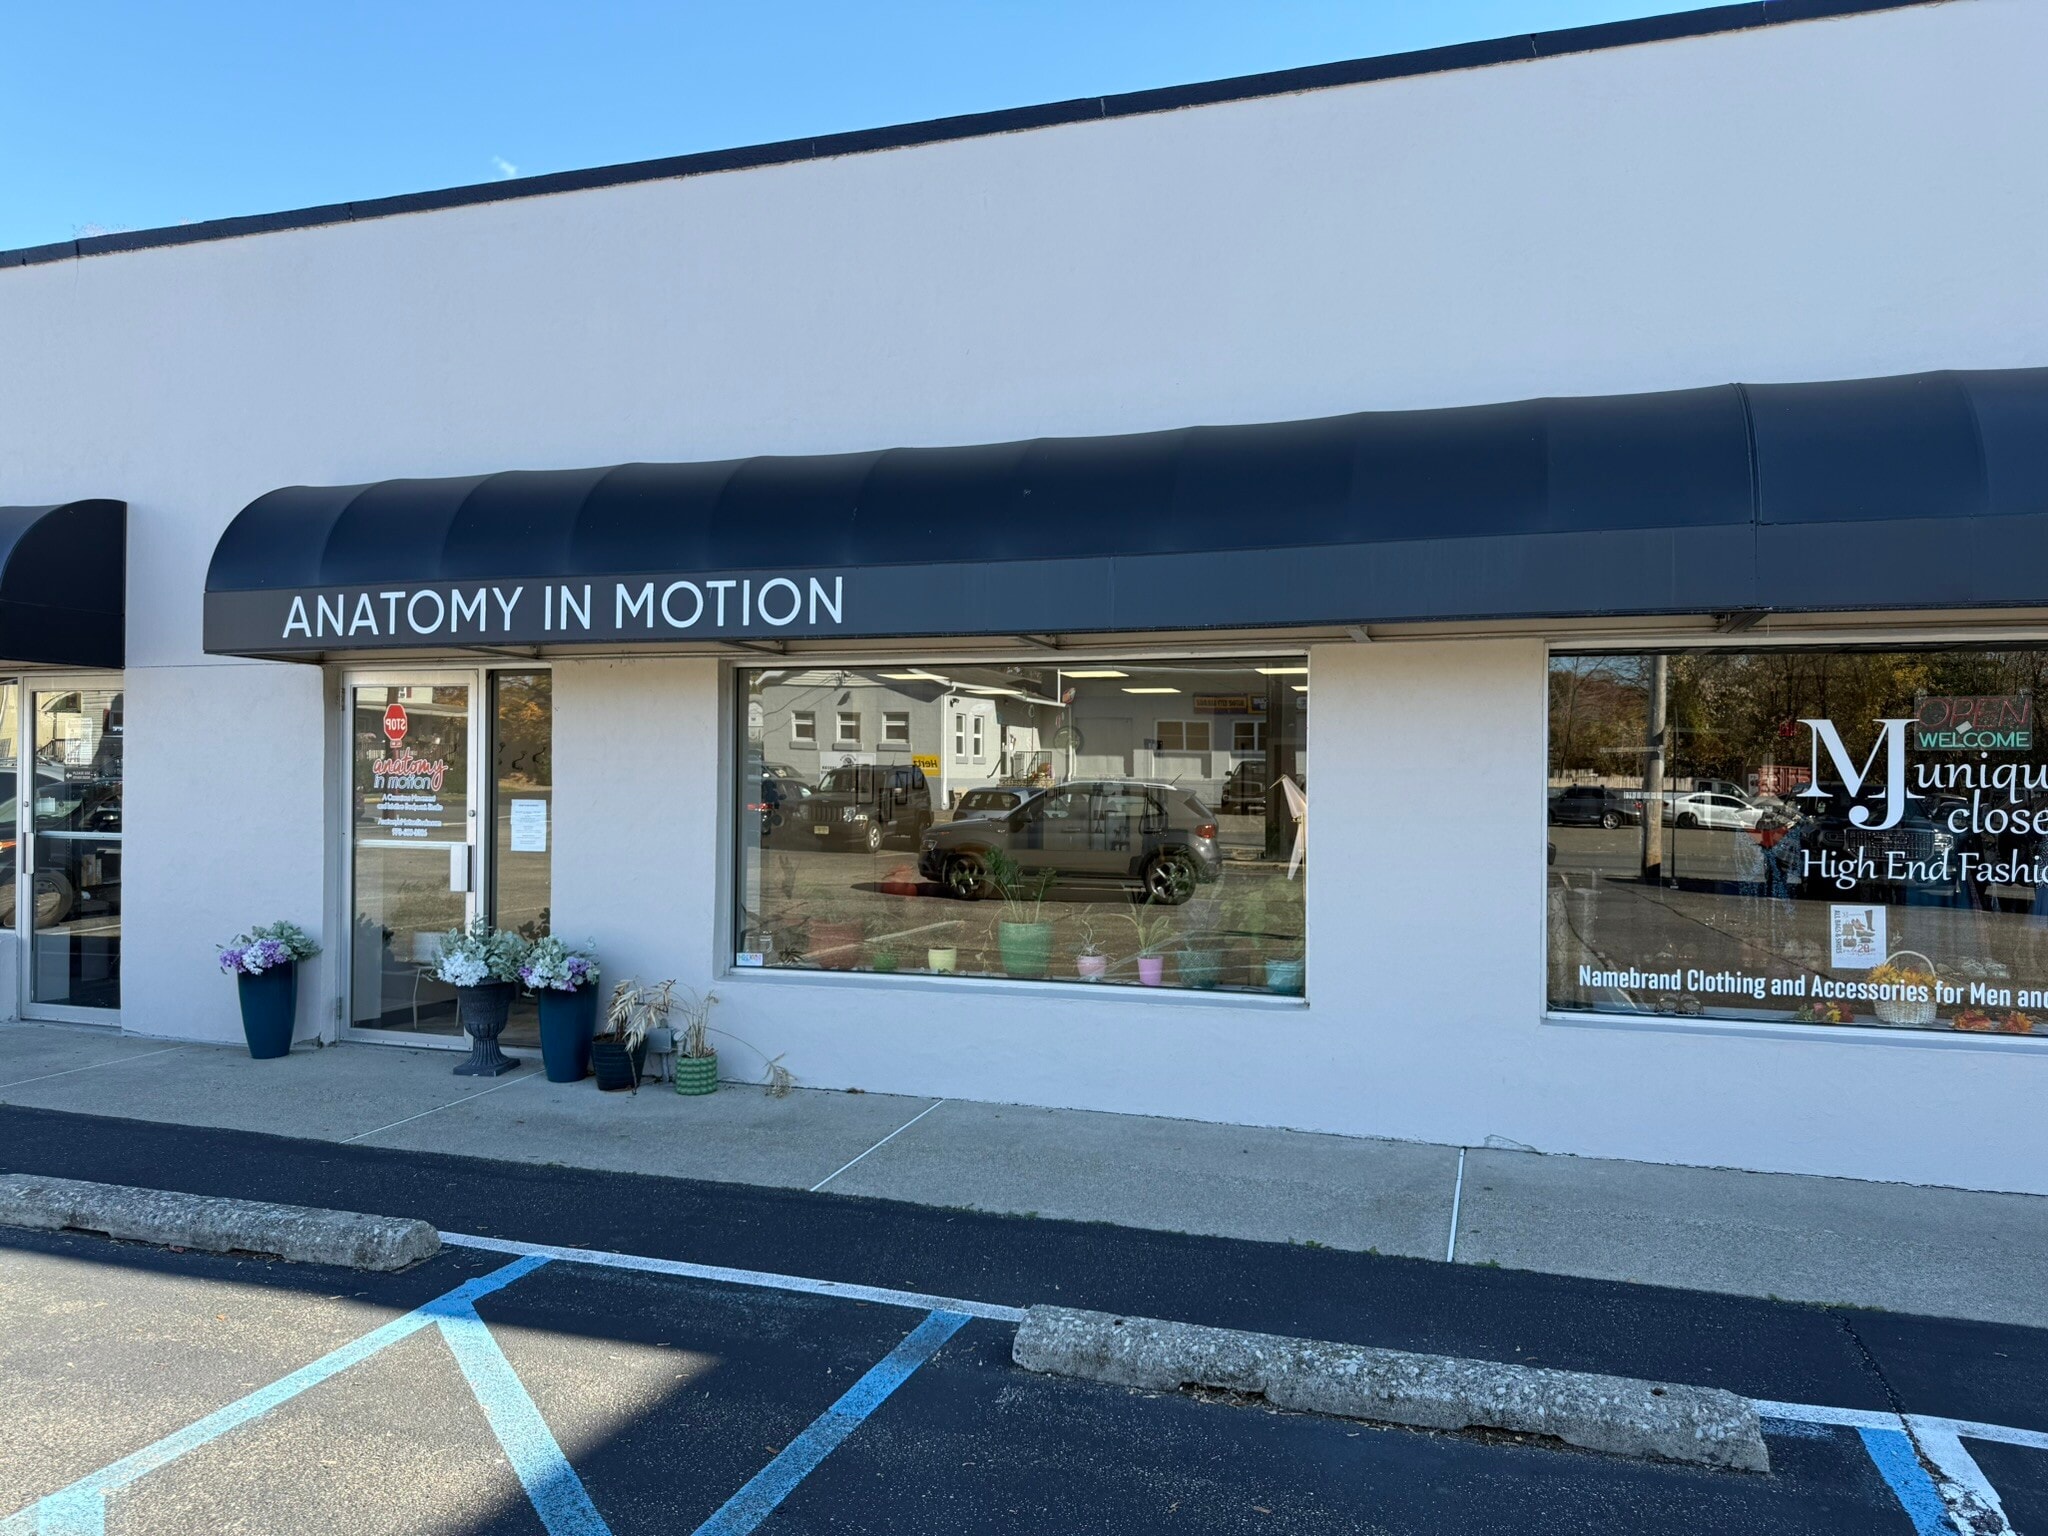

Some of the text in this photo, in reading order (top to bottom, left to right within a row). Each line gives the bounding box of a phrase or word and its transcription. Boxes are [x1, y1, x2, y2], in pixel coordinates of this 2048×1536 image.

[282, 576, 843, 639] ANATOMY IN MOTION
[1917, 698, 2029, 729] OPEN
[1919, 731, 2030, 748] WELCOME
[373, 746, 449, 792] anatomy
[373, 773, 431, 790] in motion
[1796, 718, 2048, 831] MJ uniqu
[1947, 789, 2048, 834] close
[1801, 846, 1878, 890] High
[1884, 848, 1952, 881] End
[1579, 964, 1682, 992] Namebrand
[1687, 969, 1767, 999] Clothing
[1771, 974, 1806, 997] and
[1810, 974, 1929, 1003] Accessories
[1935, 980, 1965, 1004] for
[1970, 981, 2011, 1007] Men
